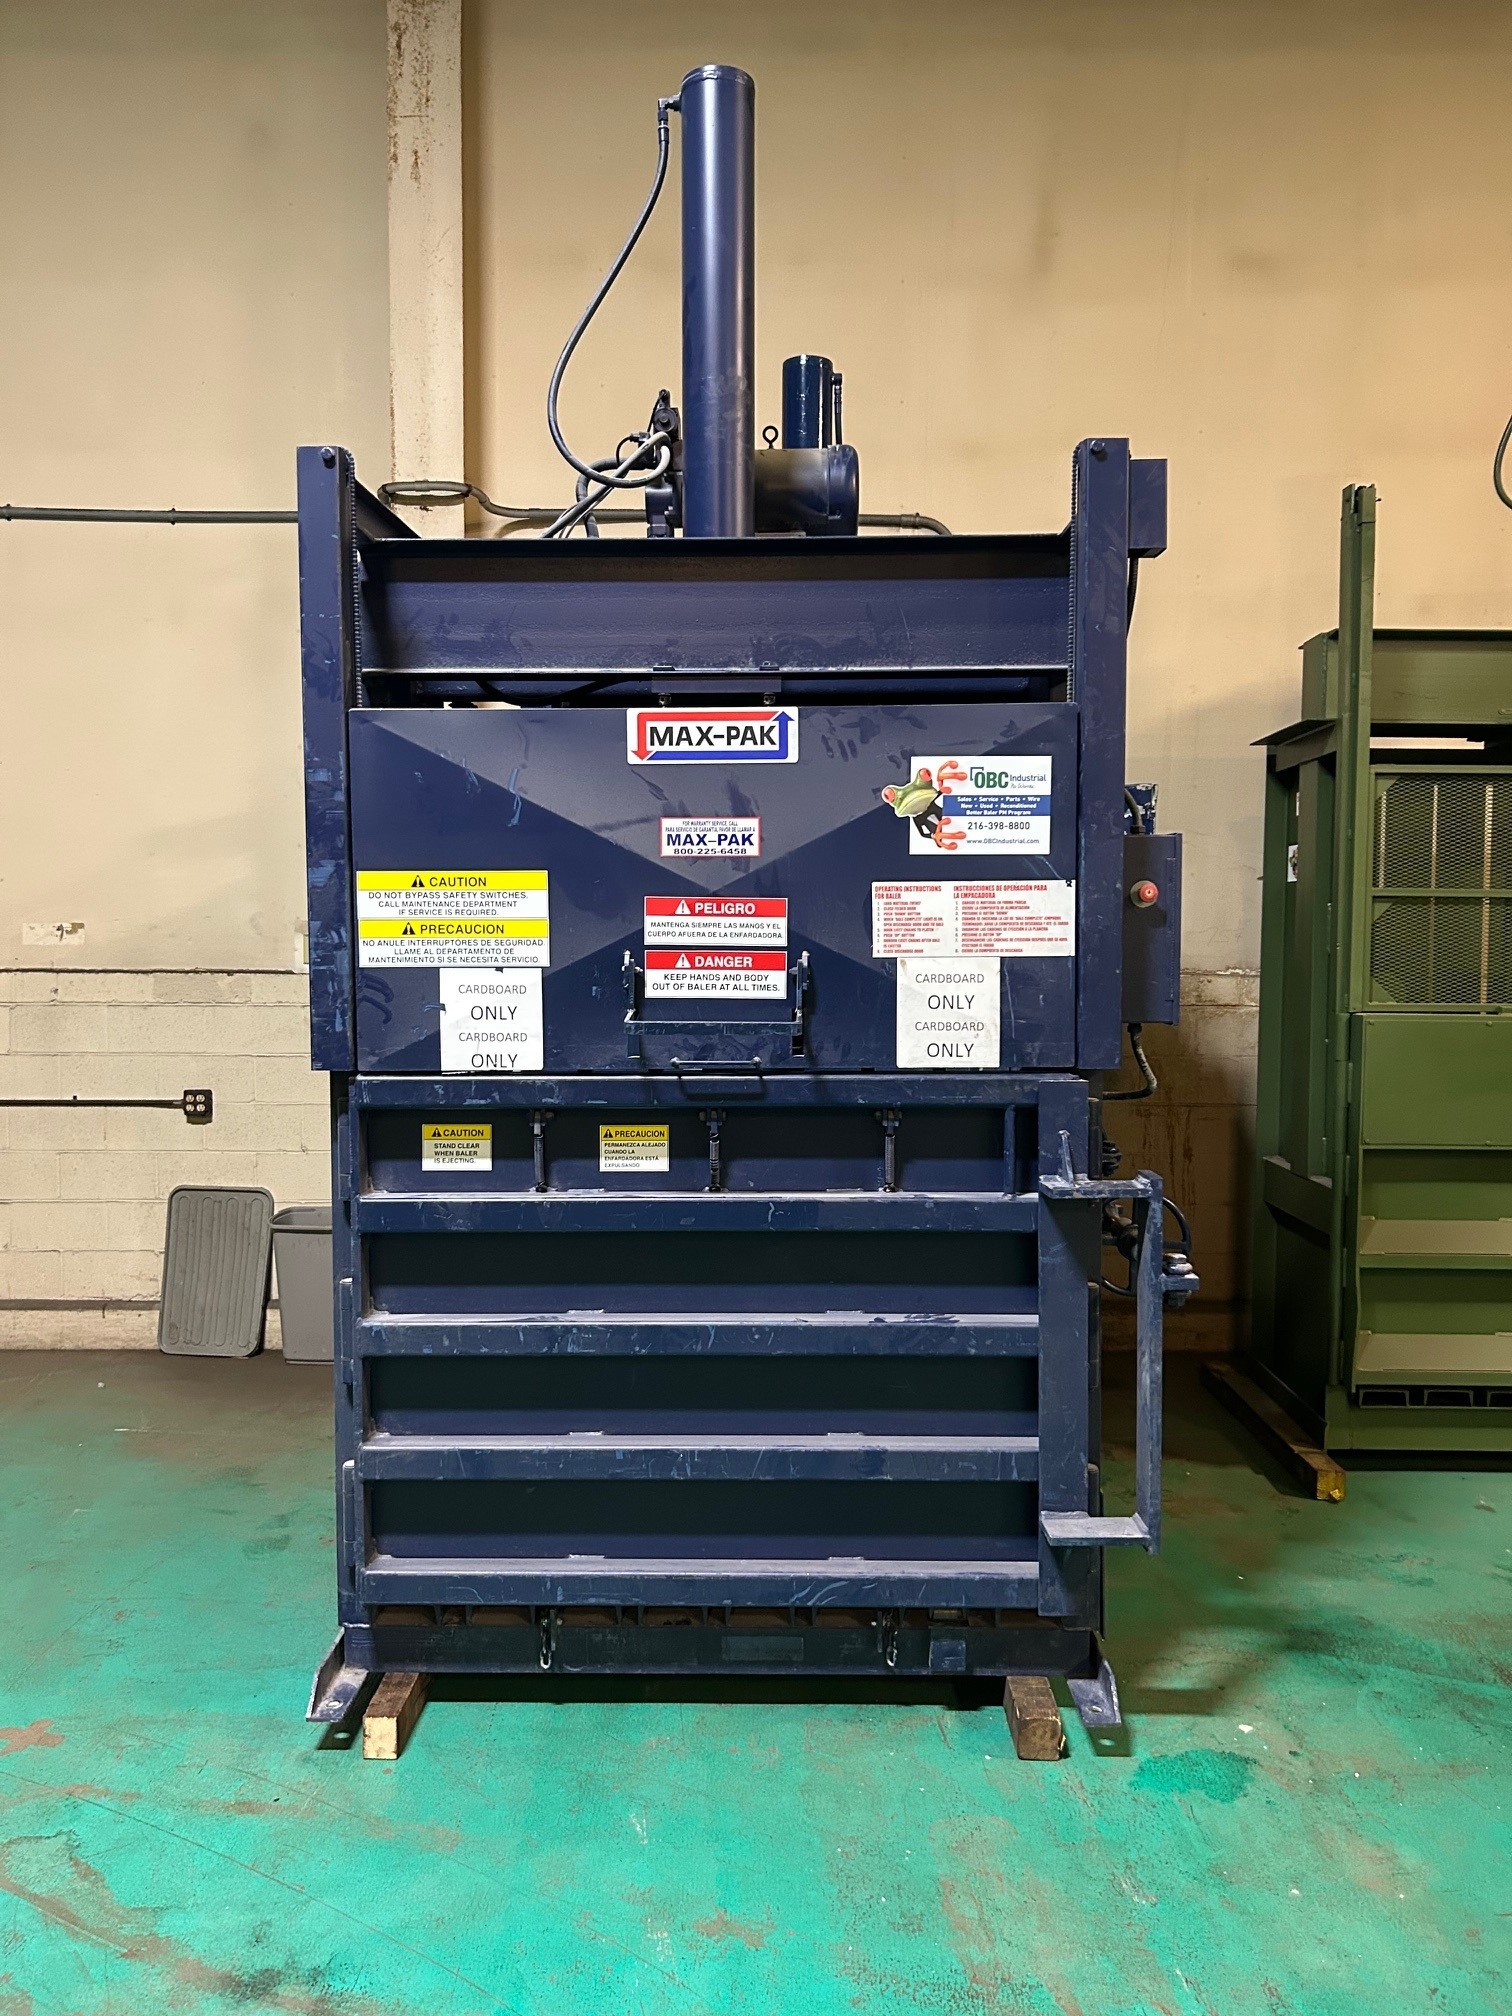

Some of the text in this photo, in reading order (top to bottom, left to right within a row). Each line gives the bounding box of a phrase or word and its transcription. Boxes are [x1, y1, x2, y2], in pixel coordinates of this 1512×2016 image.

[650, 725, 777, 746] MAX-PAK
[974, 772, 1009, 788] OBC
[1009, 774, 1046, 782] Industrial
[968, 822, 1031, 830] 216-398-8800
[667, 834, 754, 846] MAX-PAK
[429, 877, 486, 887] CAUTION
[695, 902, 756, 915] PELIGRO
[420, 924, 504, 935] PRECAUCION
[695, 956, 753, 968] DANGER
[915, 974, 984, 984] CARDBOARD
[458, 984, 527, 994] CARDBOARD
[927, 995, 975, 1010] ONLY
[470, 1005, 518, 1020] ONLY
[914, 1021, 984, 1031] CARDBOARD
[458, 1032, 528, 1042] CARDBOARD
[926, 1043, 974, 1058] ONLY
[471, 1054, 518, 1068] ONLY
